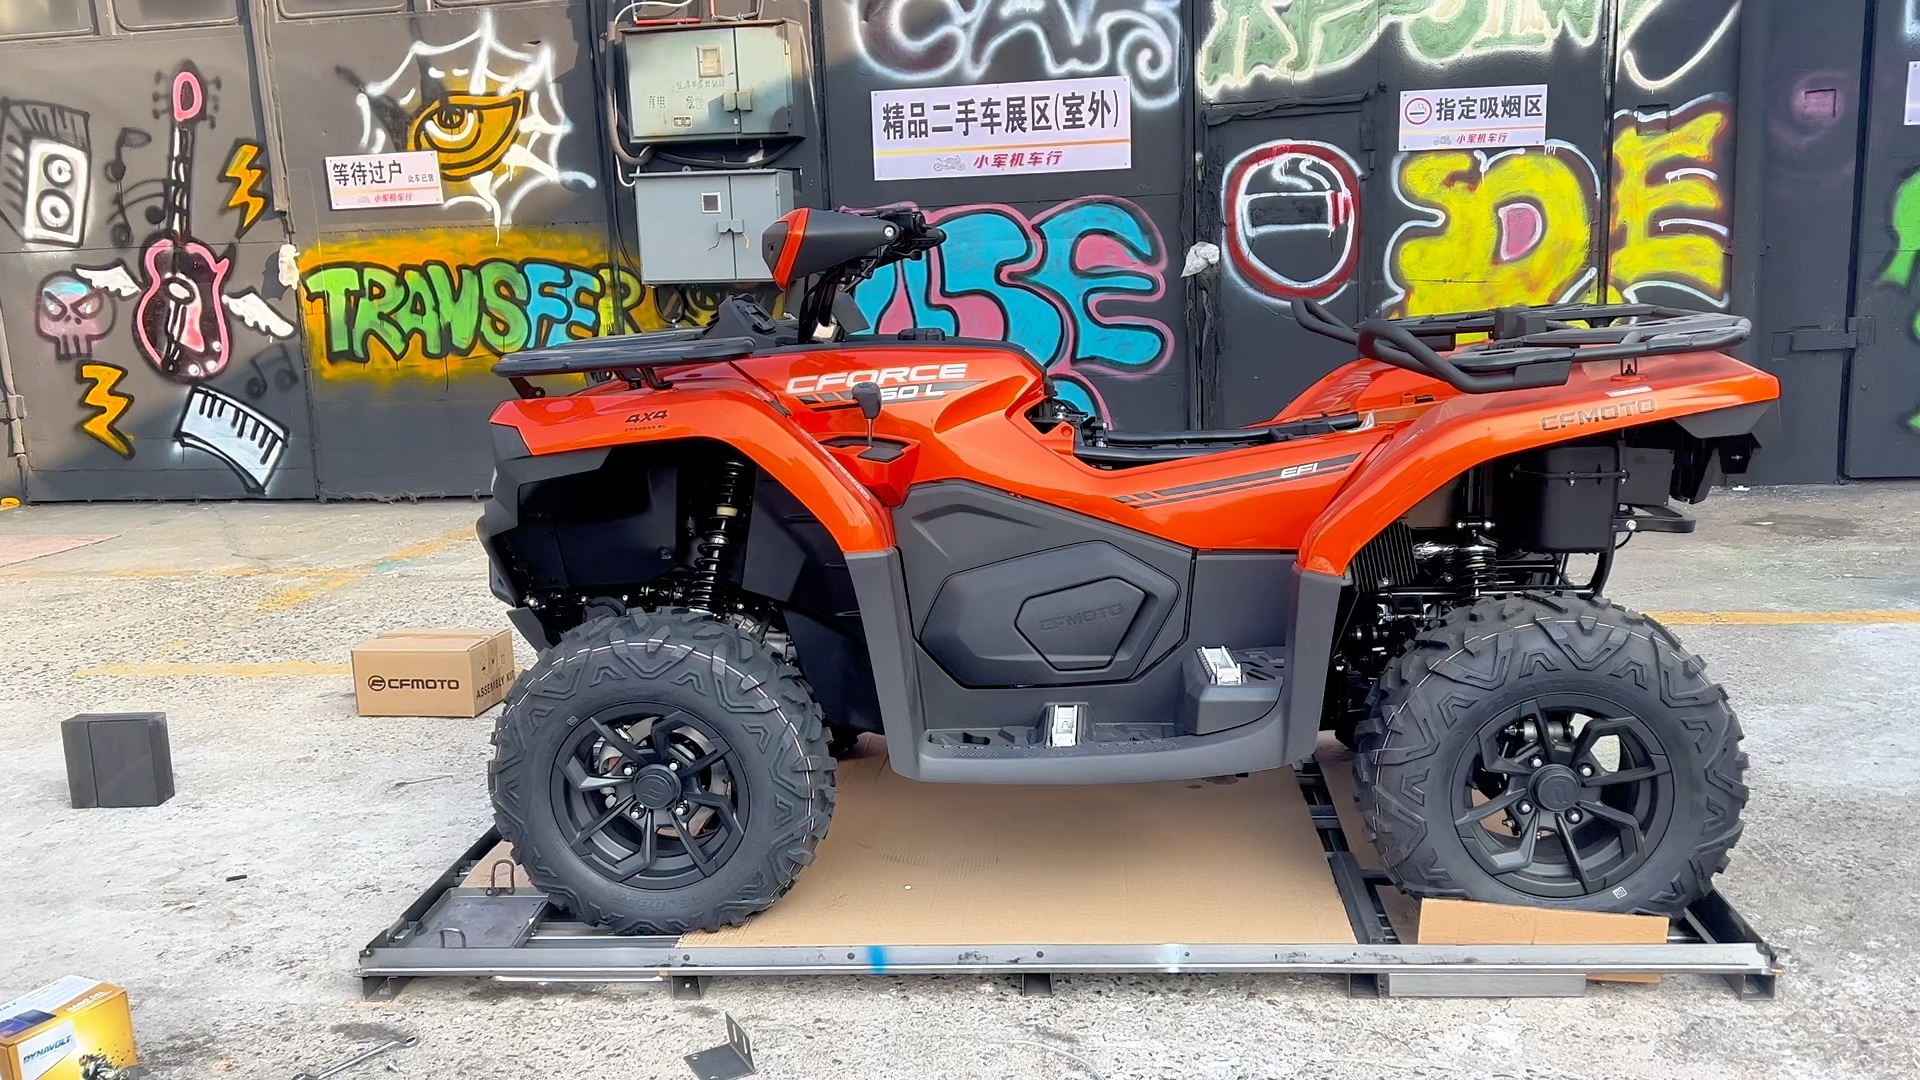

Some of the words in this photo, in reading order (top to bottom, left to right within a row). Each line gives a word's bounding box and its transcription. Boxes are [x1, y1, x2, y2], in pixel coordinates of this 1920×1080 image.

[882, 90, 1119, 140] 精品二手车展区(室外)
[1436, 94, 1542, 121] 指定吸烟区
[1456, 132, 1508, 144] 小军机车行
[973, 150, 1063, 168] 小军机车行
[332, 160, 402, 186] 等待过户
[786, 363, 968, 394] CFORCE
[879, 385, 920, 401] 50
[925, 383, 945, 397] L
[1541, 398, 1656, 431] CFMOTO
[1280, 462, 1319, 479] EFI
[1039, 604, 1124, 632] CFMOTO
[388, 678, 460, 690] CFMOTO
[476, 677, 505, 700] ASSEMBLY
[23, 1034, 72, 1064] DYNAVOLT
